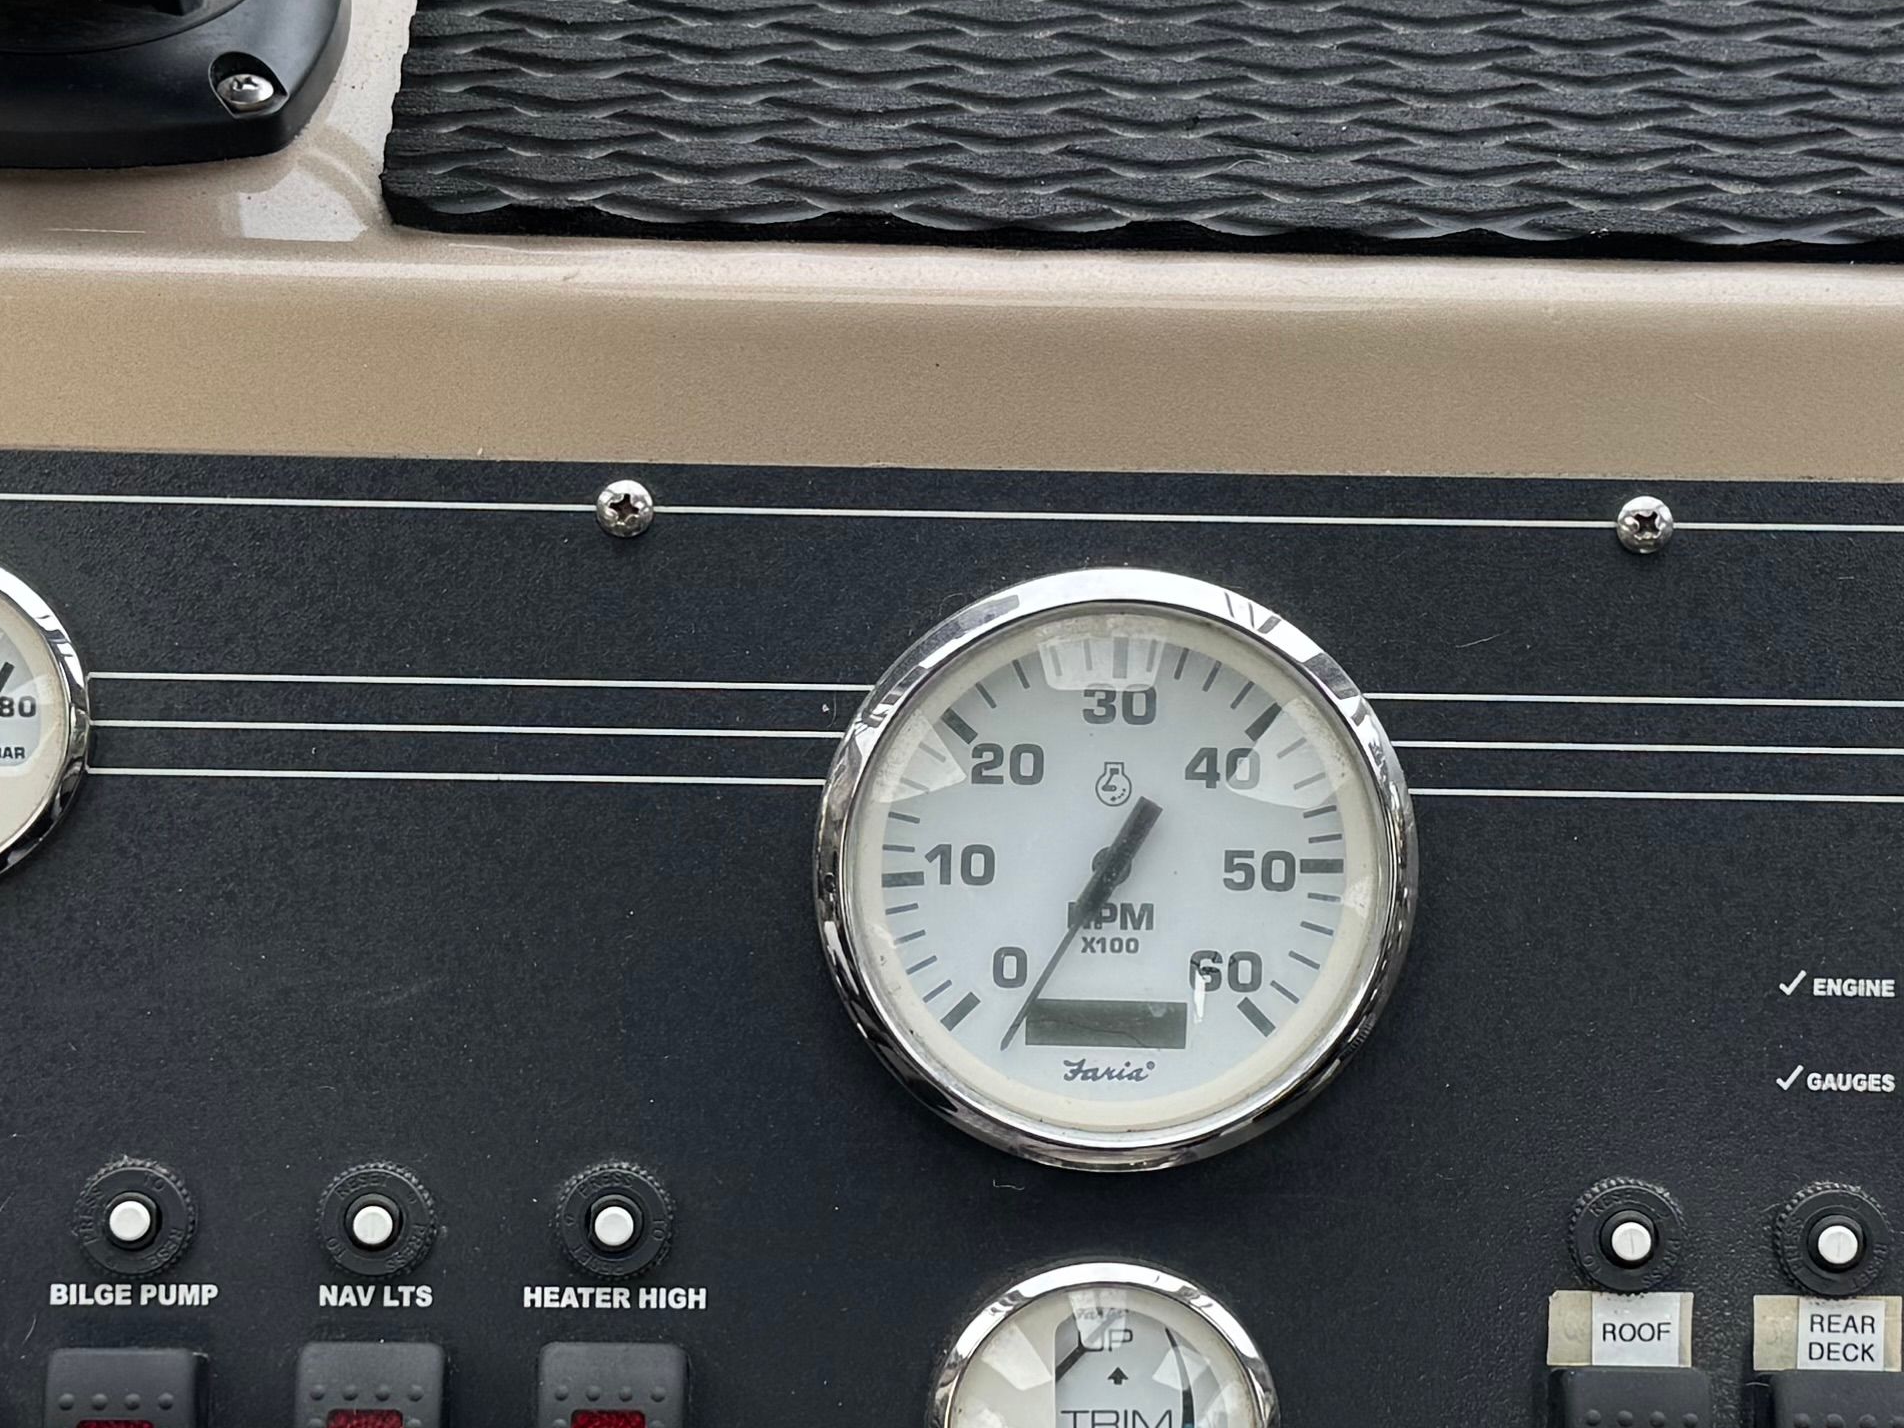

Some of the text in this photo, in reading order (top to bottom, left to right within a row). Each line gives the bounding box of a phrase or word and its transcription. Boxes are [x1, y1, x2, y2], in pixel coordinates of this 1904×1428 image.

[1082, 683, 1157, 726] 30
[970, 743, 1045, 786] 20
[1185, 747, 1261, 790] 40
[924, 844, 996, 886] 10
[1222, 849, 1297, 892] 50
[1081, 936, 1140, 955] X100
[992, 946, 1028, 989] 0
[1189, 950, 1263, 993] 60
[1813, 978, 1896, 997] ENGINE
[1806, 1072, 1896, 1092] GAUGES
[49, 1283, 218, 1306] BILGE PUMP
[318, 1284, 434, 1308] NAV LTS
[523, 1286, 707, 1309] HEATER HIGH
[1602, 1322, 1672, 1342] ROOF
[1809, 1314, 1876, 1335] REAR
[1078, 1328, 1133, 1352] UP
[1807, 1342, 1875, 1362] DECK
